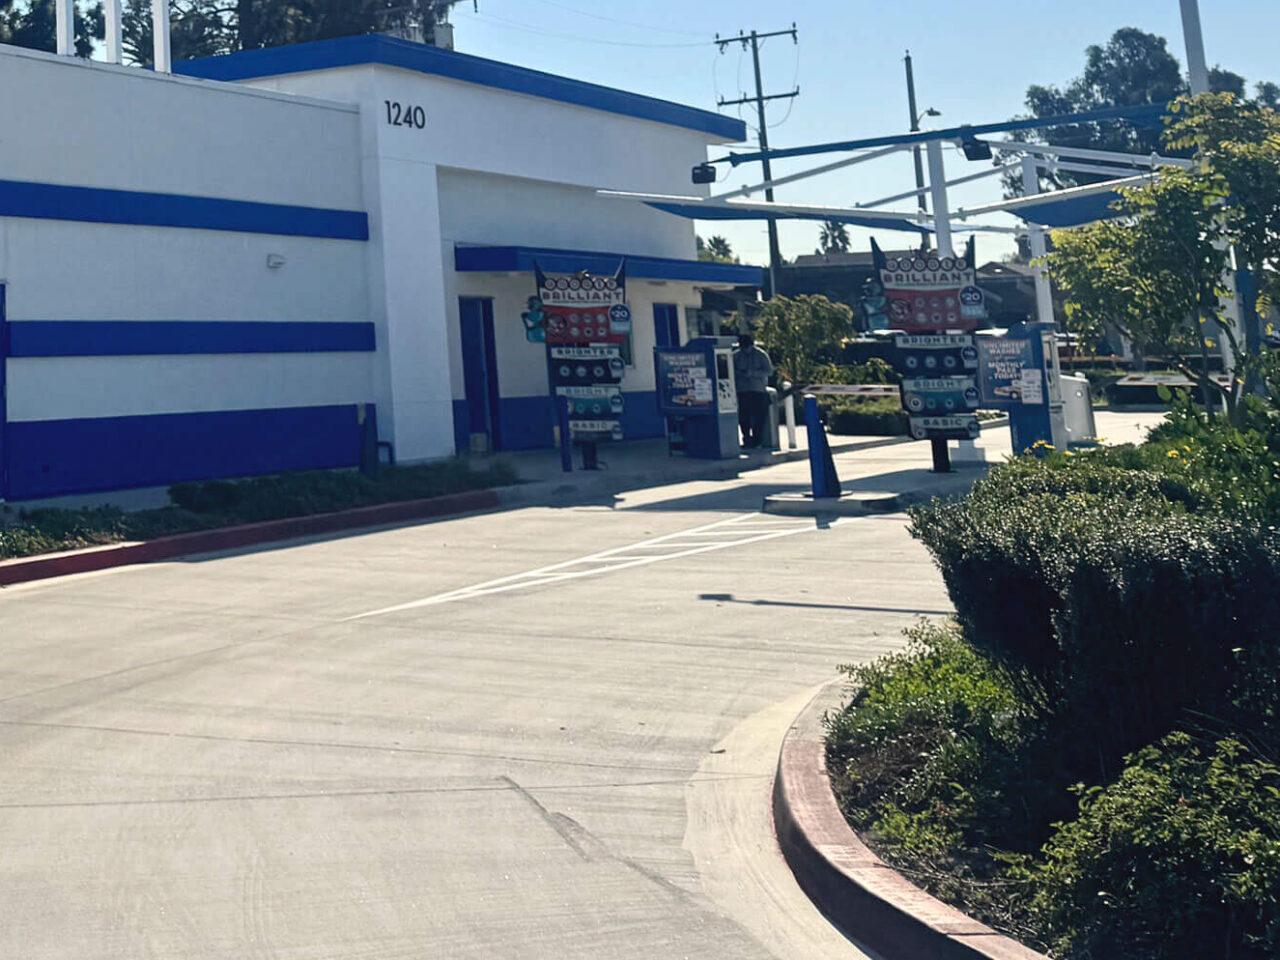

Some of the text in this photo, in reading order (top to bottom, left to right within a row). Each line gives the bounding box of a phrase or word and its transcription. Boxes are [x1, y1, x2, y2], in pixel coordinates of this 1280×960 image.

[384, 99, 426, 130] 1240
[883, 271, 972, 283] BRILLIANT
[542, 290, 623, 301] BRILLIANT
[902, 336, 965, 344] BRIGHTER
[987, 361, 1025, 369] MONTHLY
[912, 379, 963, 388] BRIGHT
[572, 421, 608, 429] BASIC
[922, 418, 963, 427] BASIC
